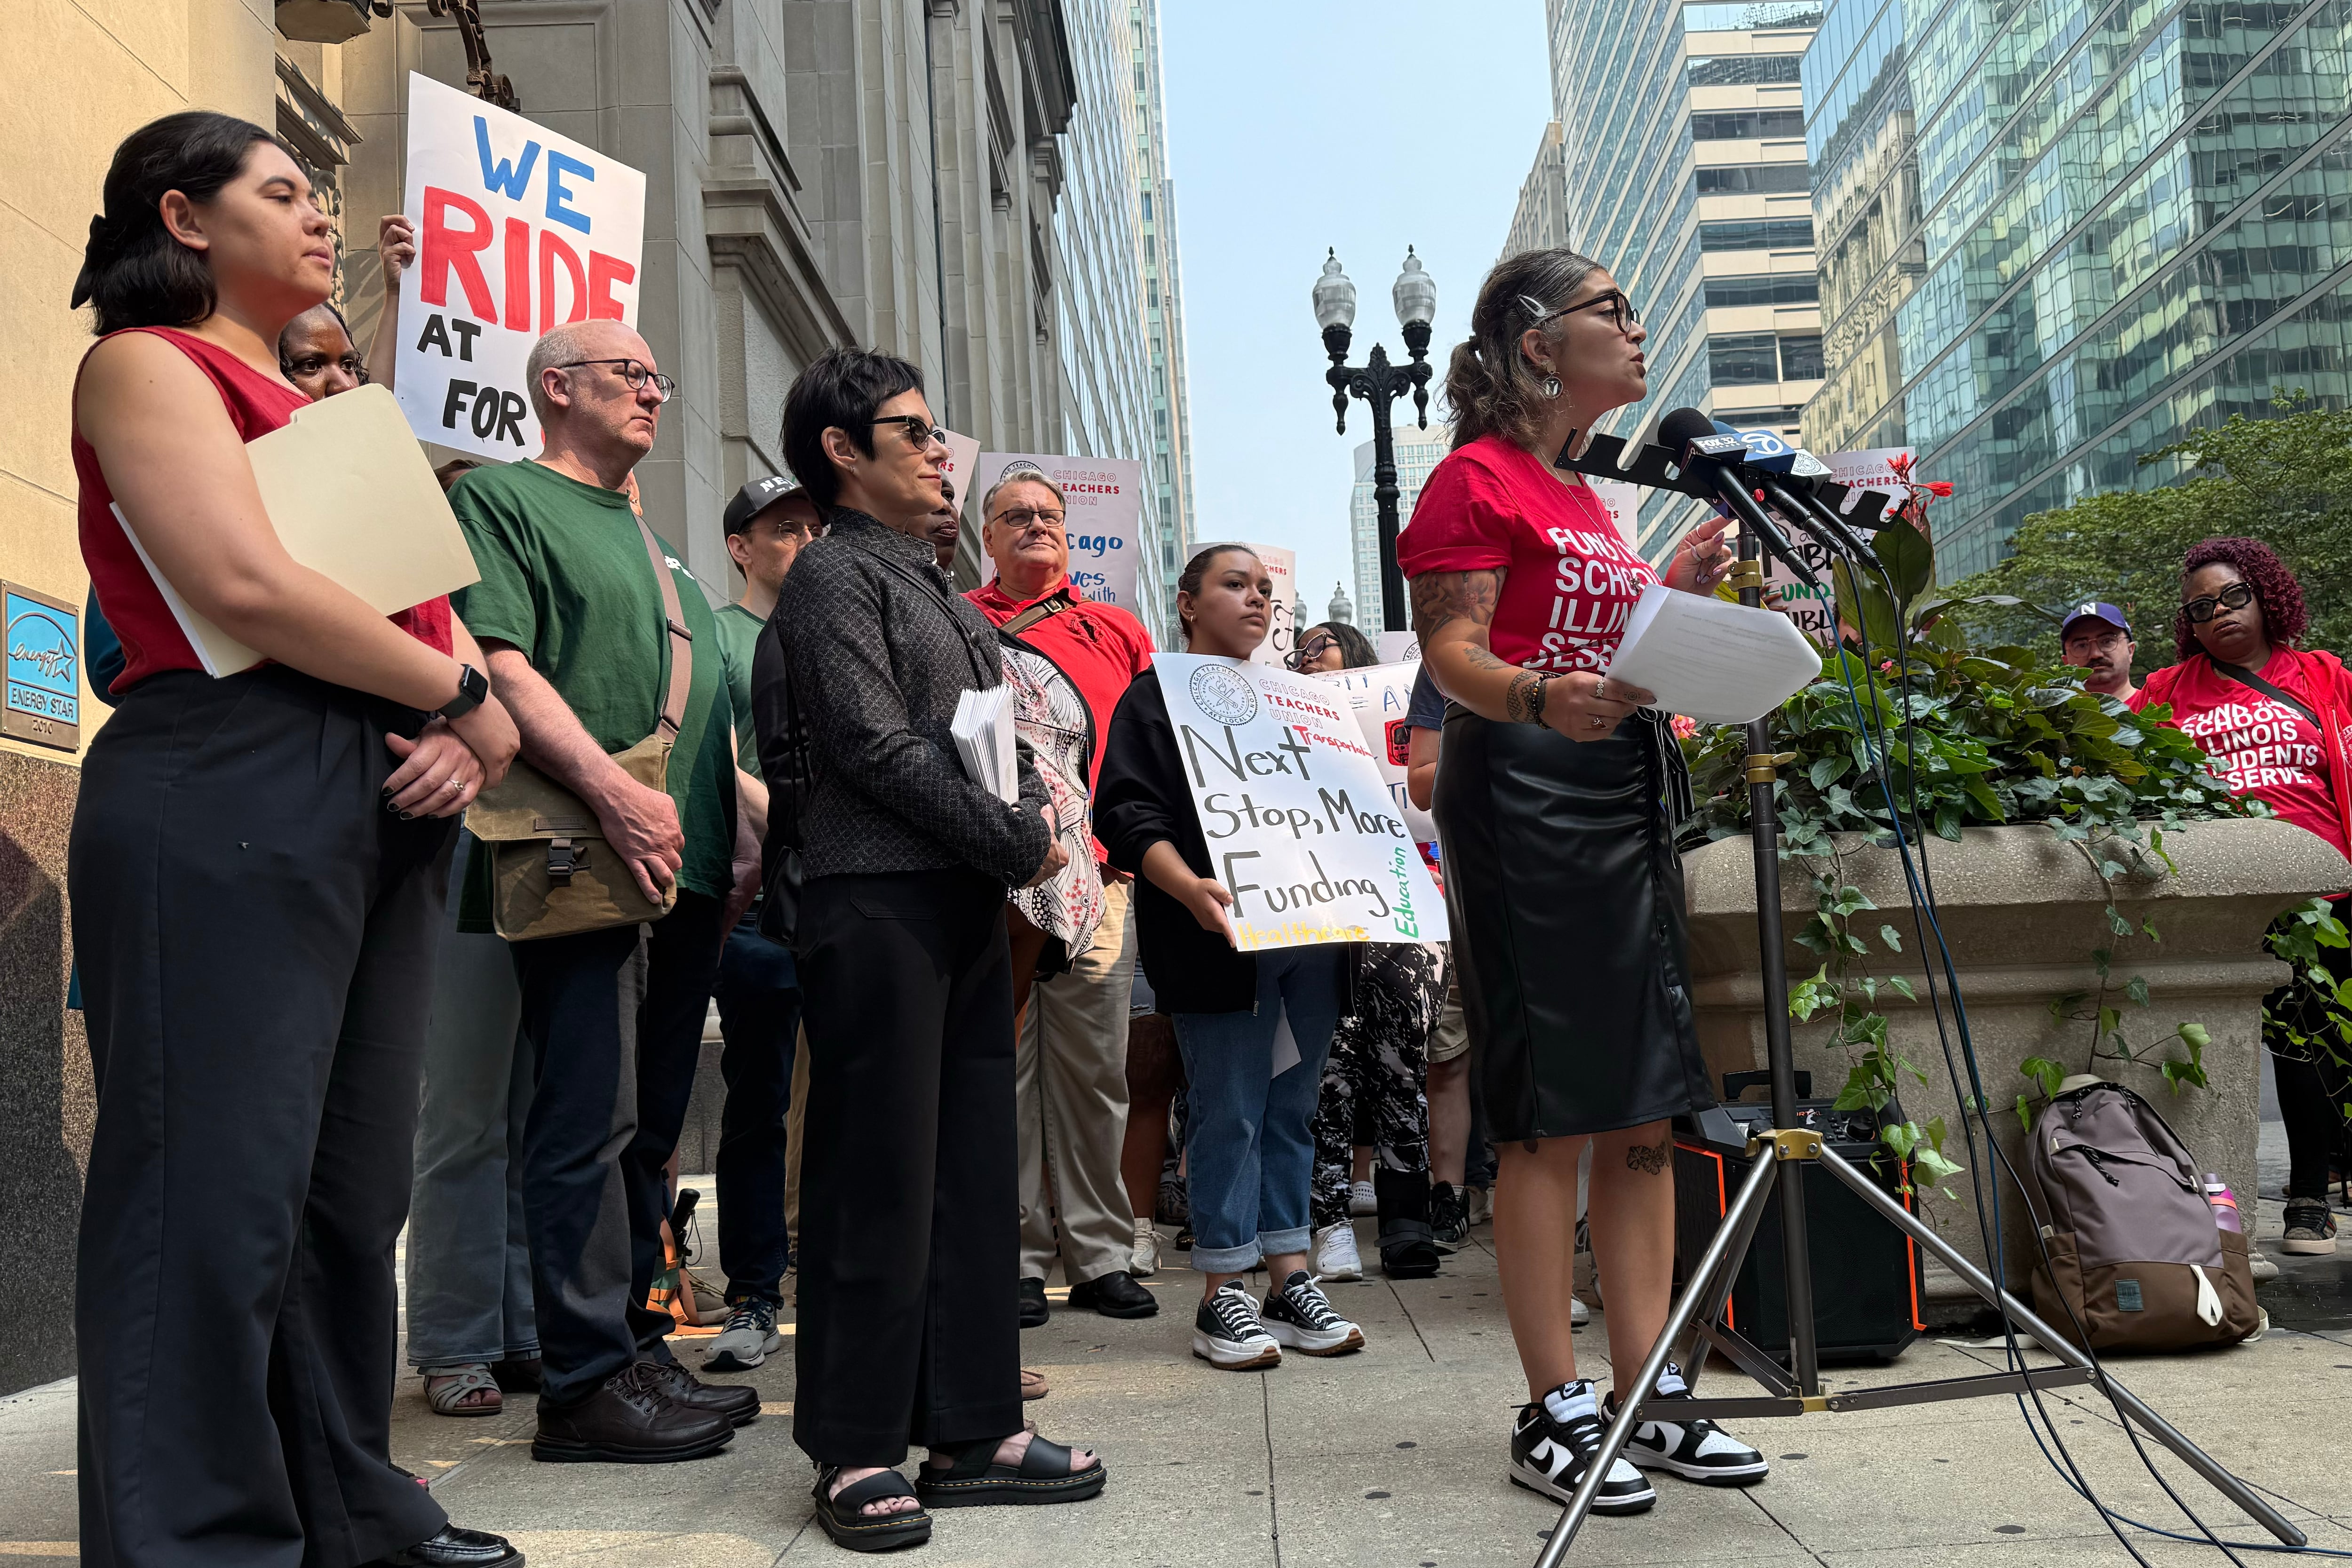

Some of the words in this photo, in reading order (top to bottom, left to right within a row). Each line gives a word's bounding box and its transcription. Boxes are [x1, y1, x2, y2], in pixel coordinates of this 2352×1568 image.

[474, 115, 595, 235] WE
[420, 185, 635, 336] RIDE
[417, 314, 482, 362] AT
[442, 378, 527, 447] FOR
[1697, 438, 1722, 447] FOX
[1720, 437, 1737, 446] 32
[1053, 470, 1116, 482] CHICAGO
[1831, 463, 1894, 478] CHICAGO
[1837, 476, 1899, 488] EACHERS
[1059, 483, 1120, 494] EACHERS
[1065, 495, 1097, 506] NION
[1065, 533, 1123, 558] cago
[1547, 527, 1620, 561] FUND
[1069, 571, 1106, 588] ves
[1556, 557, 1663, 596] SCHOOL
[1764, 580, 1835, 602] FUND
[1549, 596, 1638, 633] ILLIN
[2081, 602, 2096, 615] N
[11, 687, 48, 711] ENERGY
[50, 698, 74, 718] STAR
[1259, 679, 1330, 706] CHICAGO
[1263, 693, 1340, 721] TEACHERS
[1269, 708, 1323, 729] UNION
[2183, 703, 2249, 724] FUND
[32, 719, 53, 734] 2010
[2206, 720, 2298, 756] LINOIS
[1180, 724, 1311, 788] Next
[2224, 744, 2318, 772] UDENTS
[2226, 766, 2313, 791] SERVE.
[1204, 793, 1324, 839] Stop,
[1317, 787, 1406, 838] More
[1223, 850, 1390, 918] Funding
[1388, 846, 1419, 939] Education
[1236, 920, 1371, 949] Healthcare
